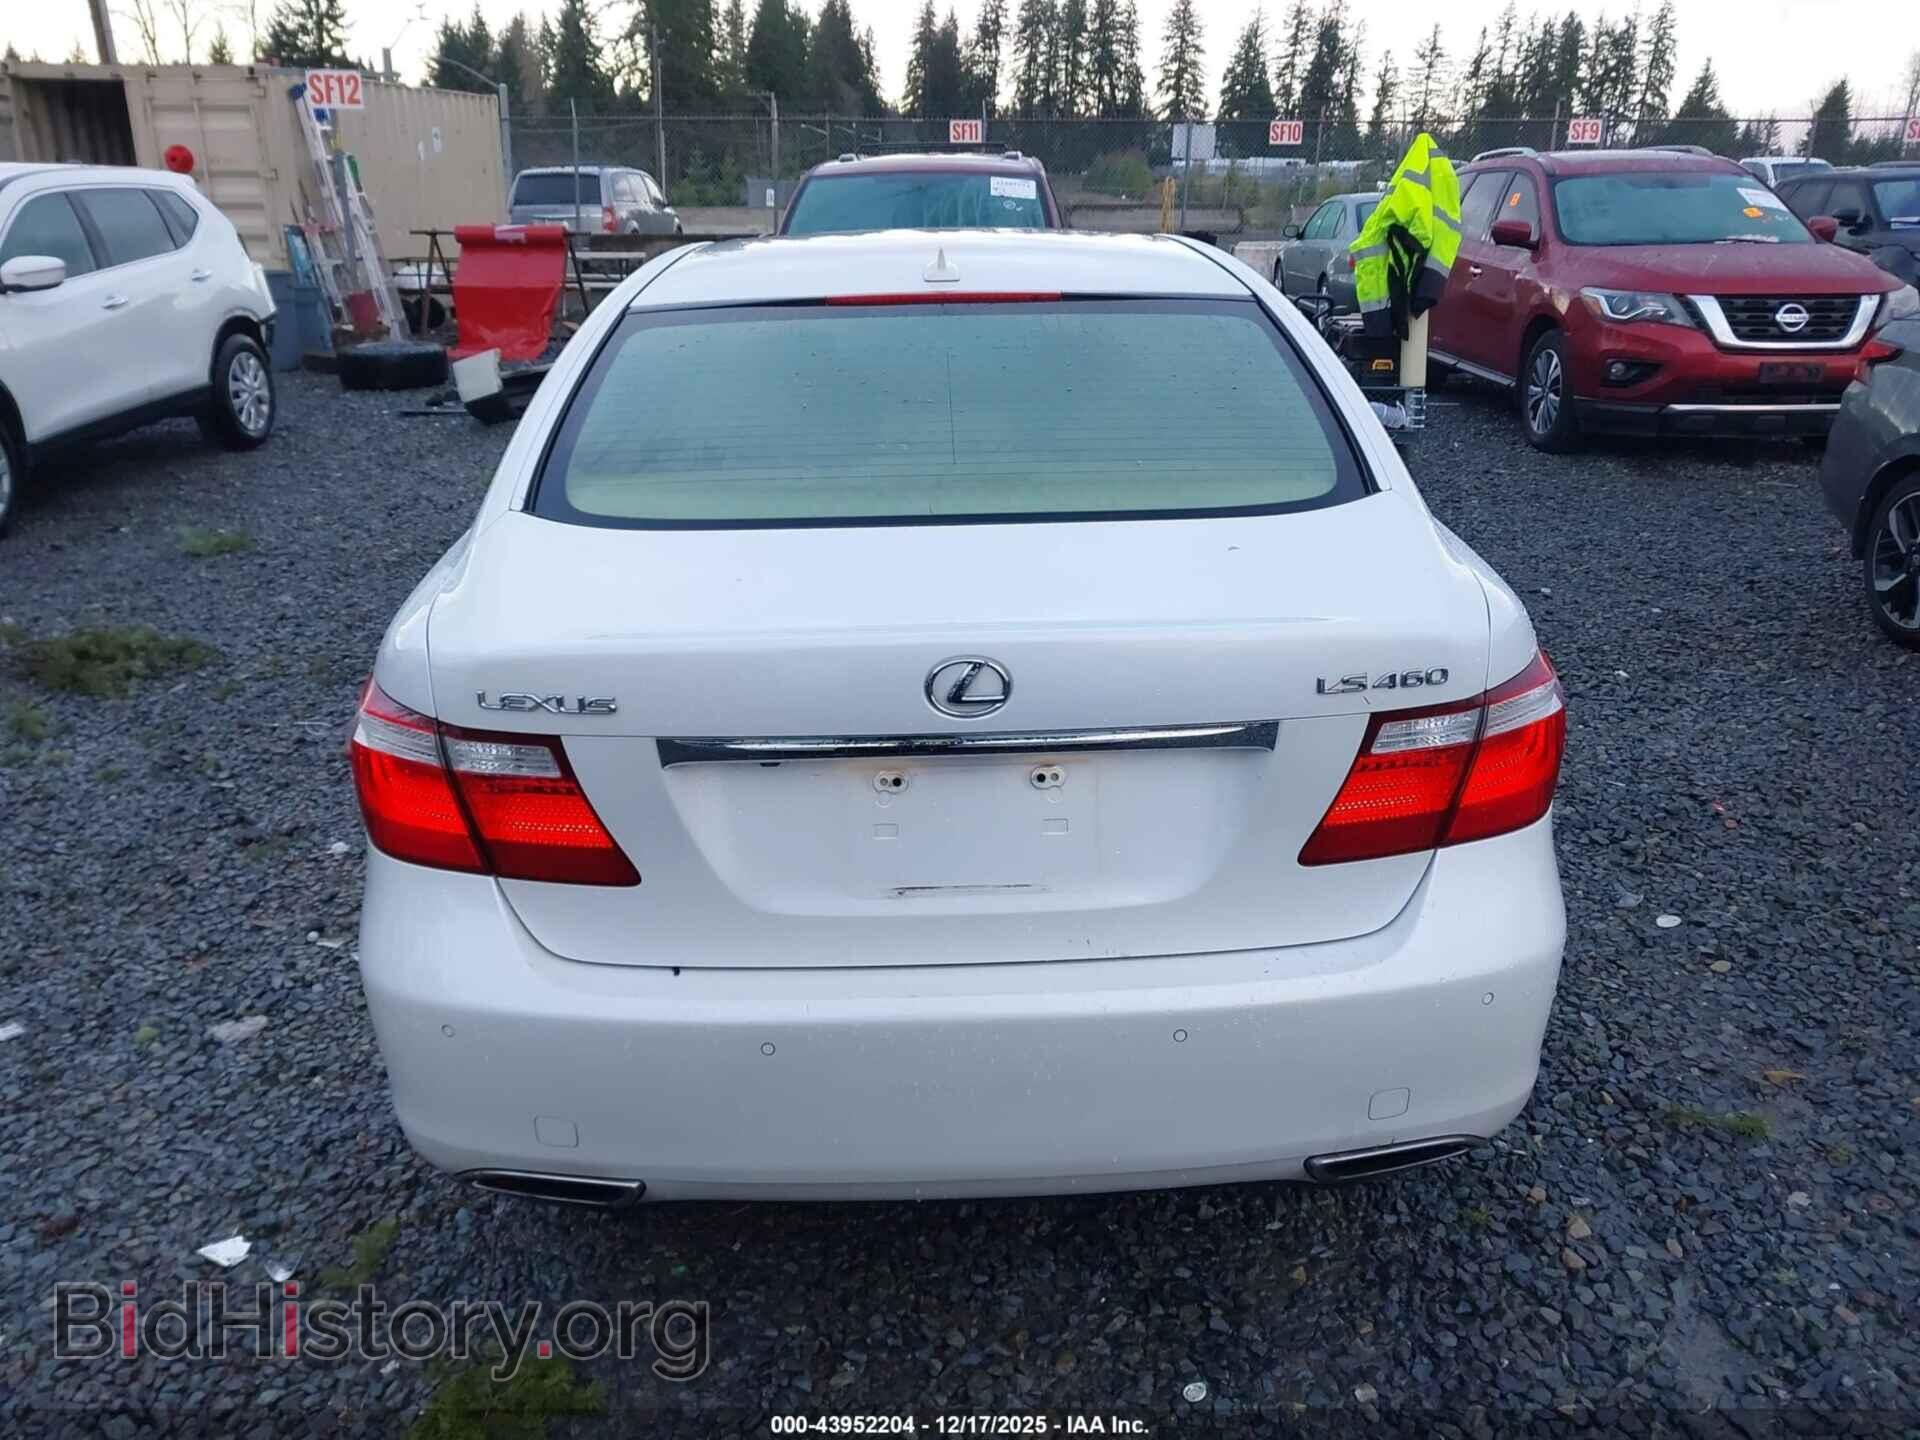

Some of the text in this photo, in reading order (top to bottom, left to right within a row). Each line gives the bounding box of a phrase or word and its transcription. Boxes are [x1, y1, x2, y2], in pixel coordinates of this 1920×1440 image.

[308, 74, 361, 105] SF12
[952, 122, 979, 141] SF11
[1271, 123, 1301, 142] SF10
[1571, 122, 1600, 140] SF9
[475, 690, 617, 715] LEXUS
